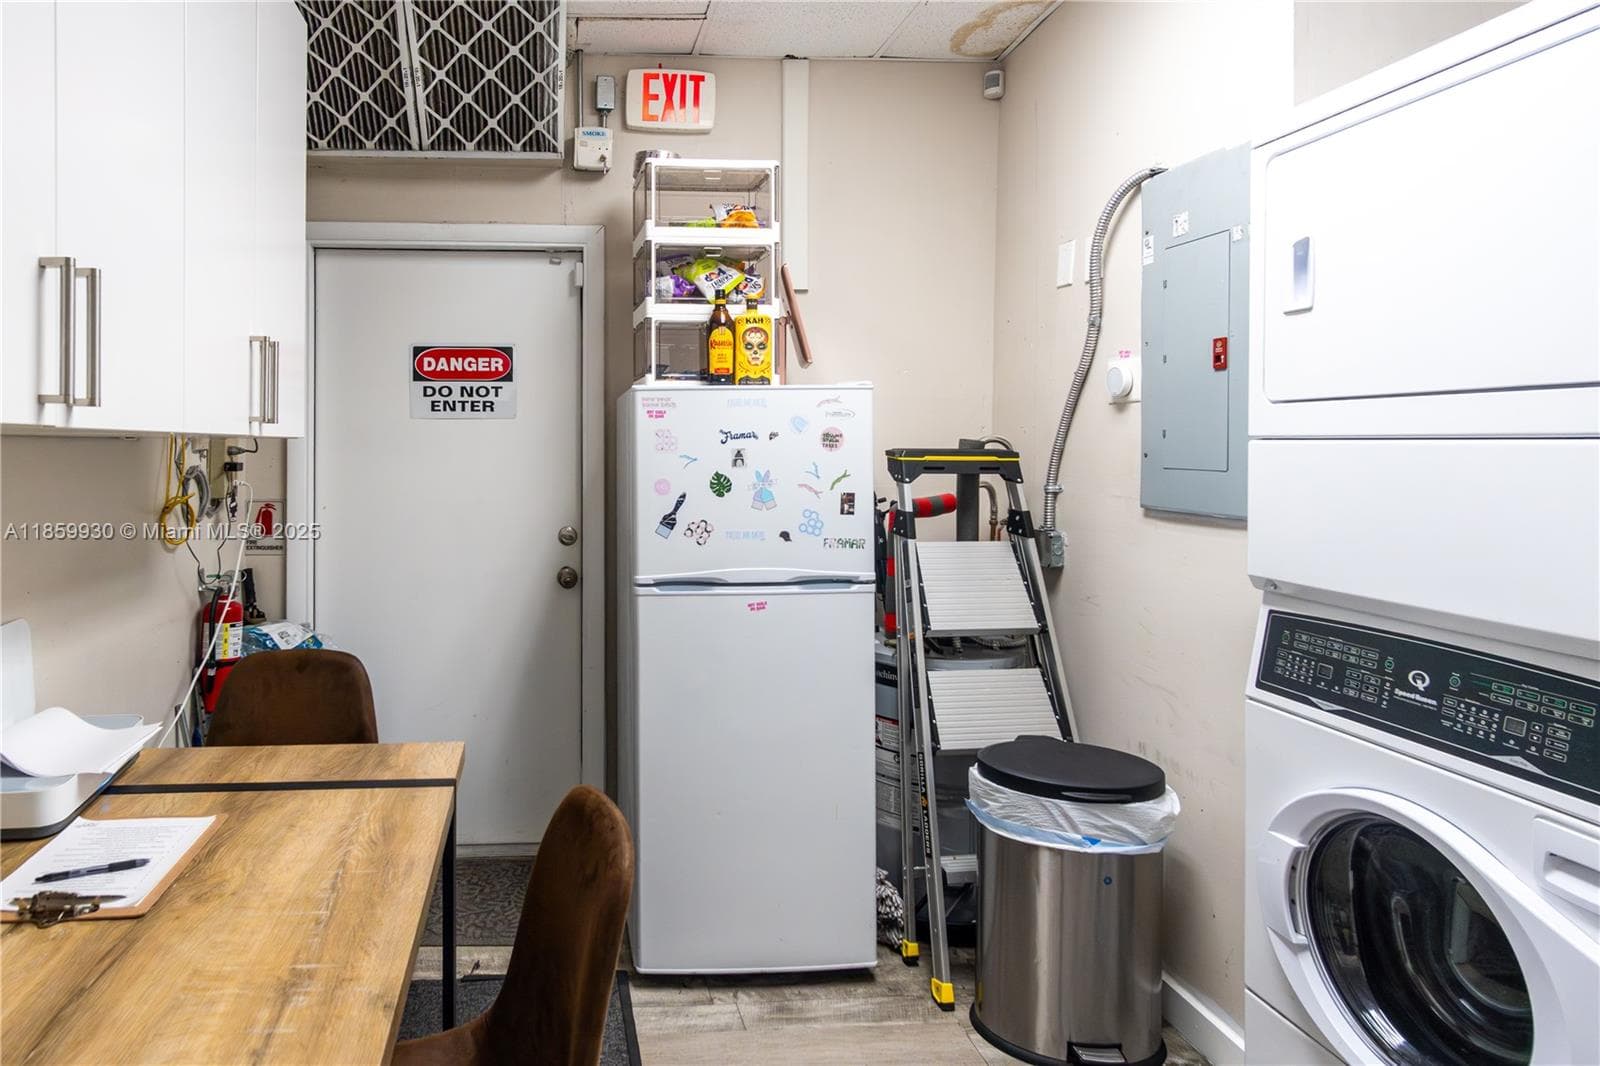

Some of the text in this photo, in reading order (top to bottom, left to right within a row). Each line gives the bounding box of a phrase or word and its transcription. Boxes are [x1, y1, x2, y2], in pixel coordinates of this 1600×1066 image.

[641, 72, 706, 123] EXIT
[423, 357, 504, 372] DANGER
[423, 386, 503, 398] DO NOT
[431, 400, 496, 412] ENTER
